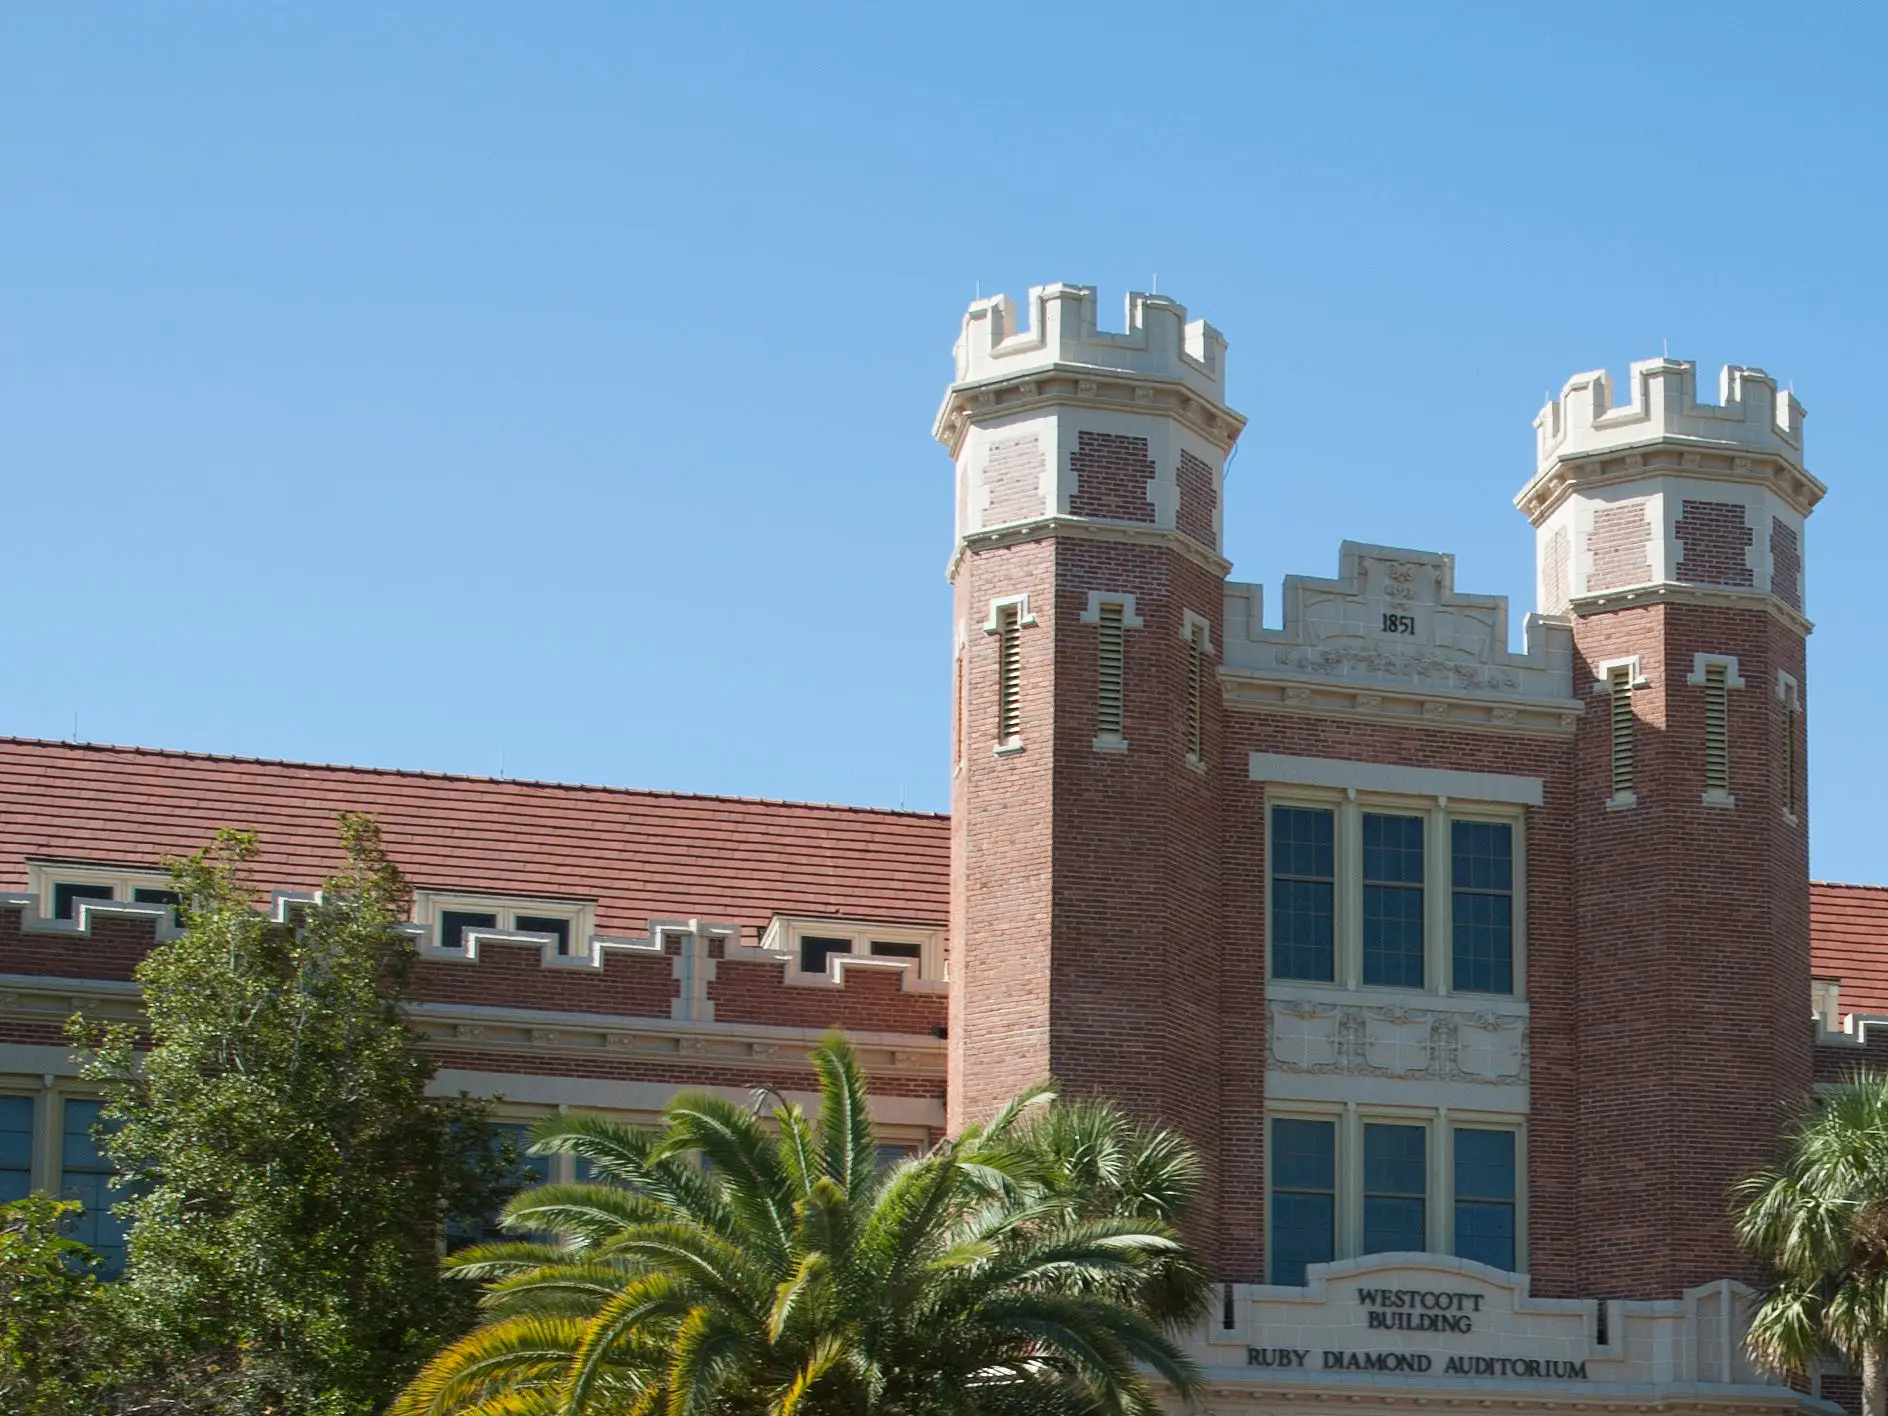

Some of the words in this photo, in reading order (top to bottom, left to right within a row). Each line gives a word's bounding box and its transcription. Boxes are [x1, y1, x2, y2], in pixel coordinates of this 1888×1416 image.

[1381, 613, 1416, 635] 1851
[1356, 1287, 1486, 1312] WESTCOTT
[1367, 1310, 1473, 1334] BUILDING
[1246, 1347, 1310, 1367] RUBY
[1322, 1350, 1432, 1373] DIAMOND
[1444, 1356, 1589, 1380] AUDITORIUM
